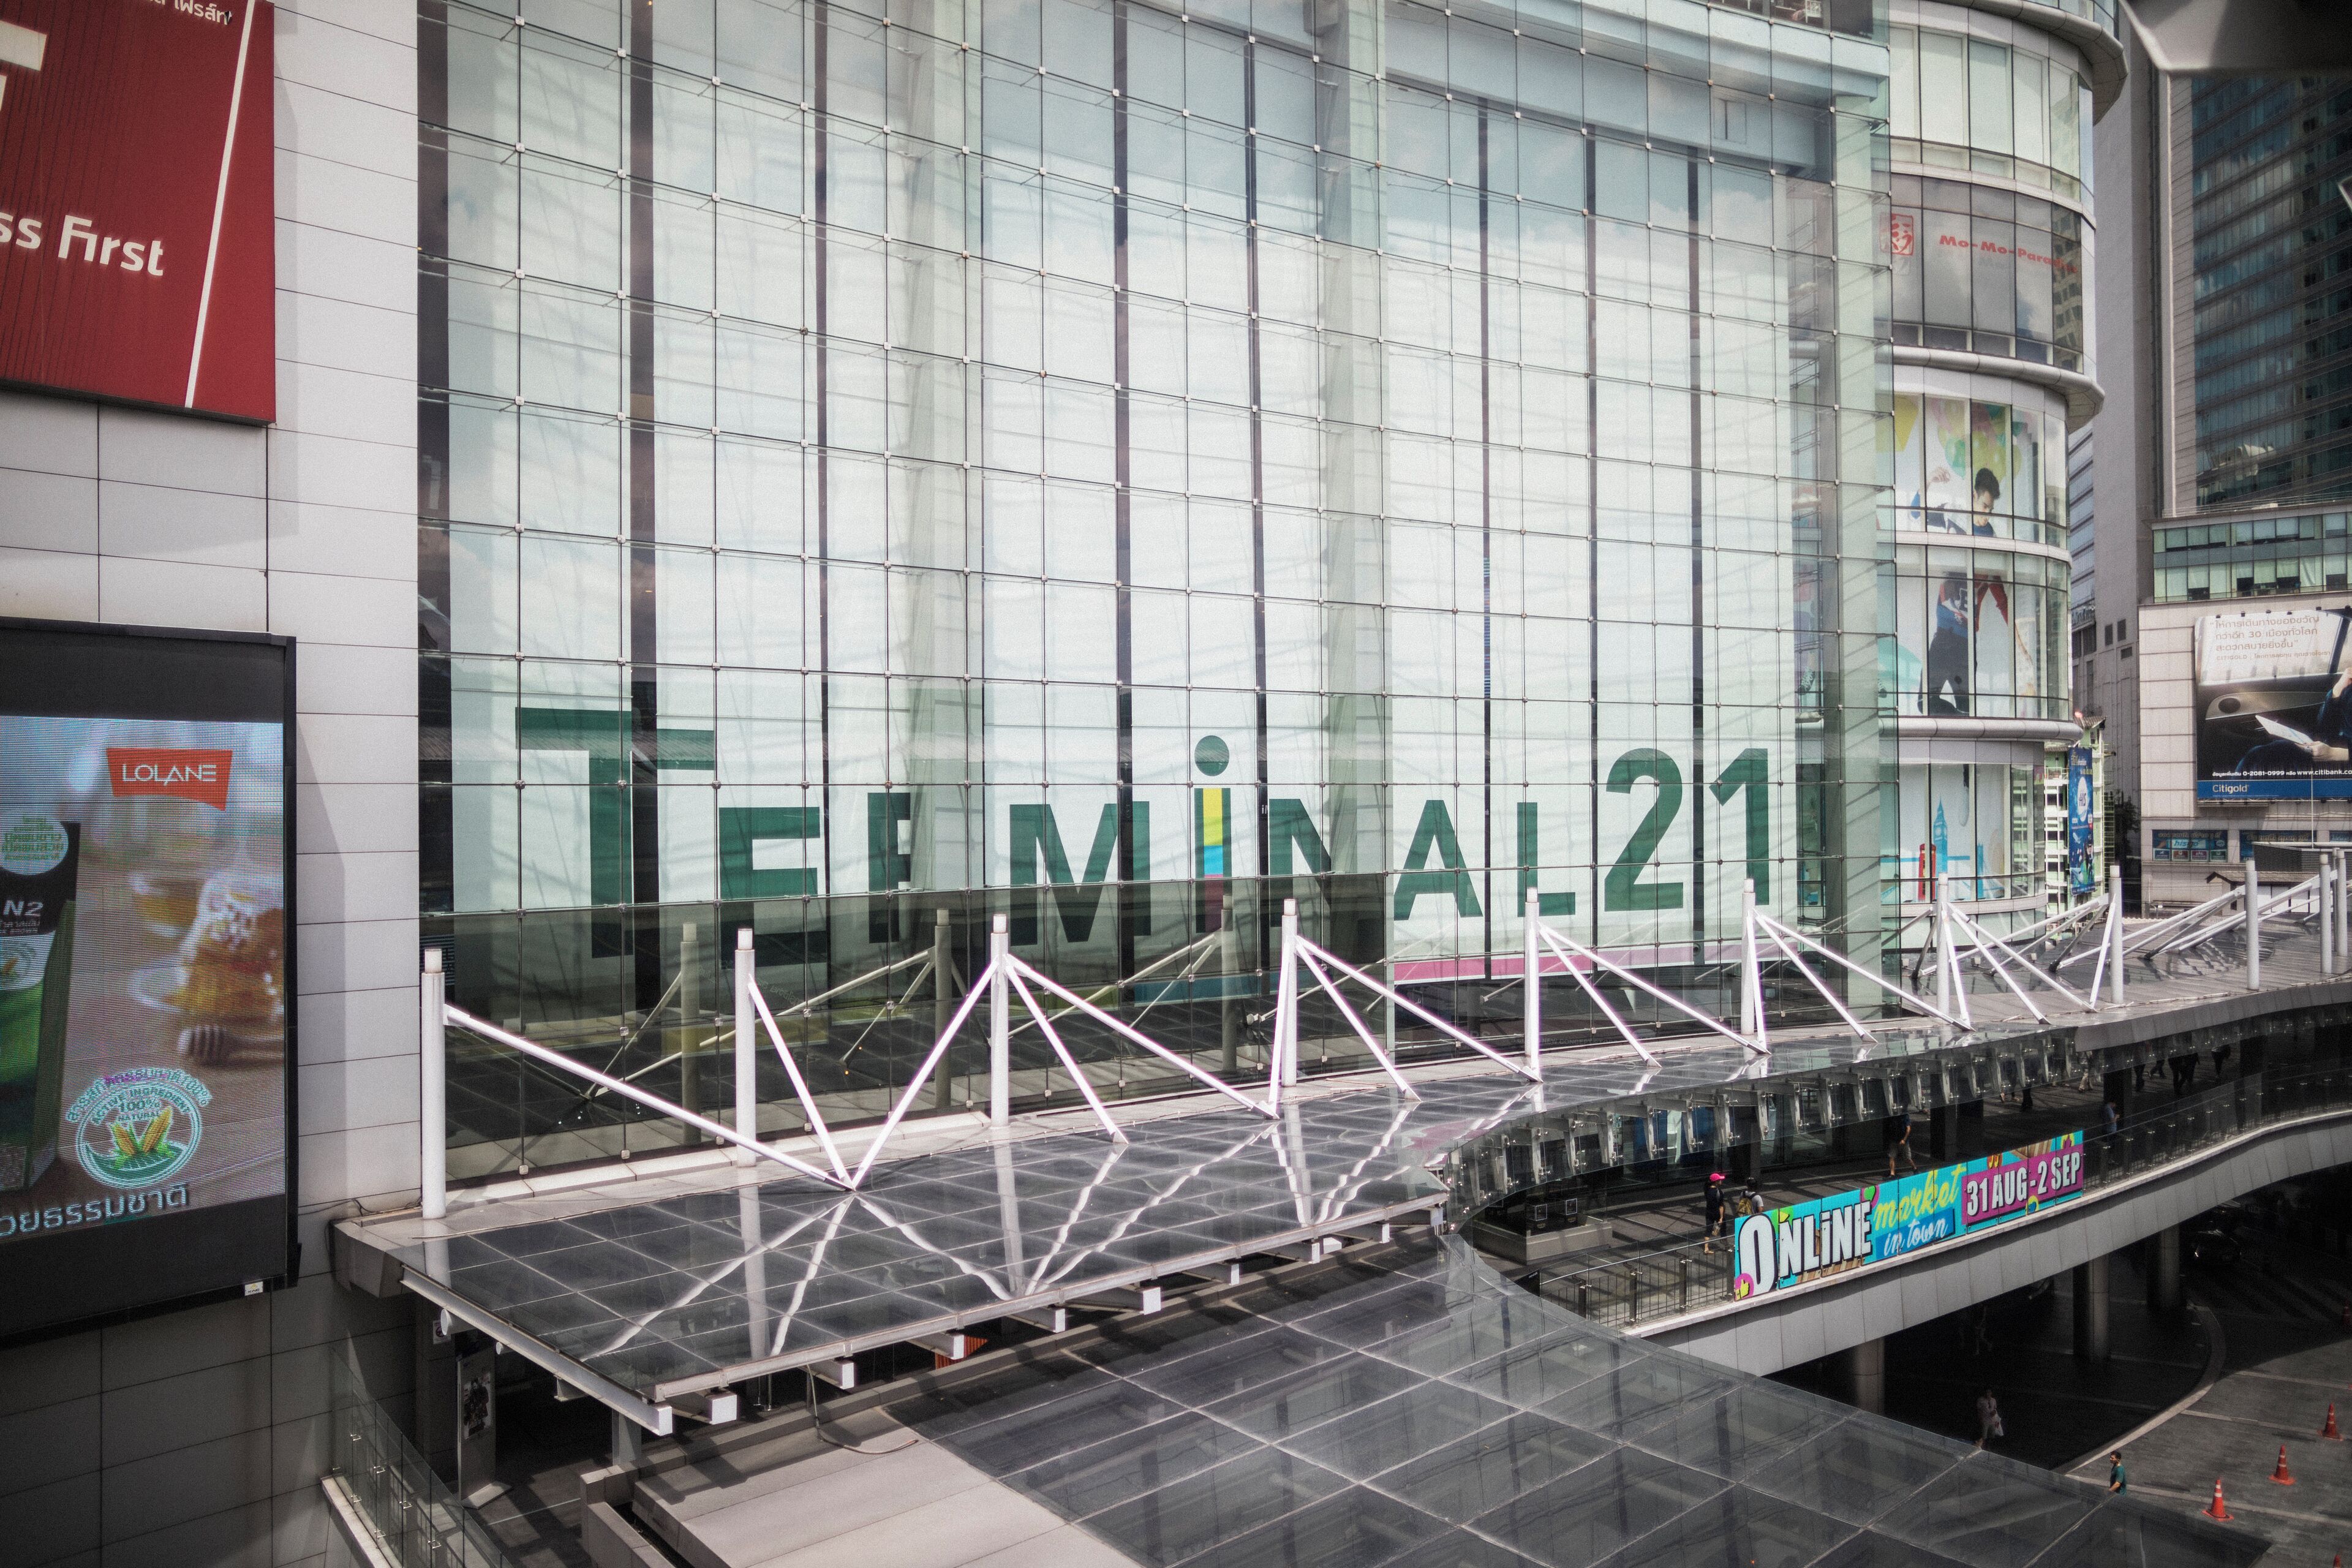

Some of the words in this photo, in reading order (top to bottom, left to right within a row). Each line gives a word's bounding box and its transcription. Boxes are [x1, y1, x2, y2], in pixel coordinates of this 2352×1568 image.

[58, 214, 164, 276] First
[122, 764, 217, 787] LOLANE
[2212, 783, 2248, 794] Citigold
[2050, 1152, 2081, 1191] SEP
[1873, 1164, 1967, 1231] market
[1883, 1229, 1905, 1257] in
[1907, 1216, 1948, 1247] town
